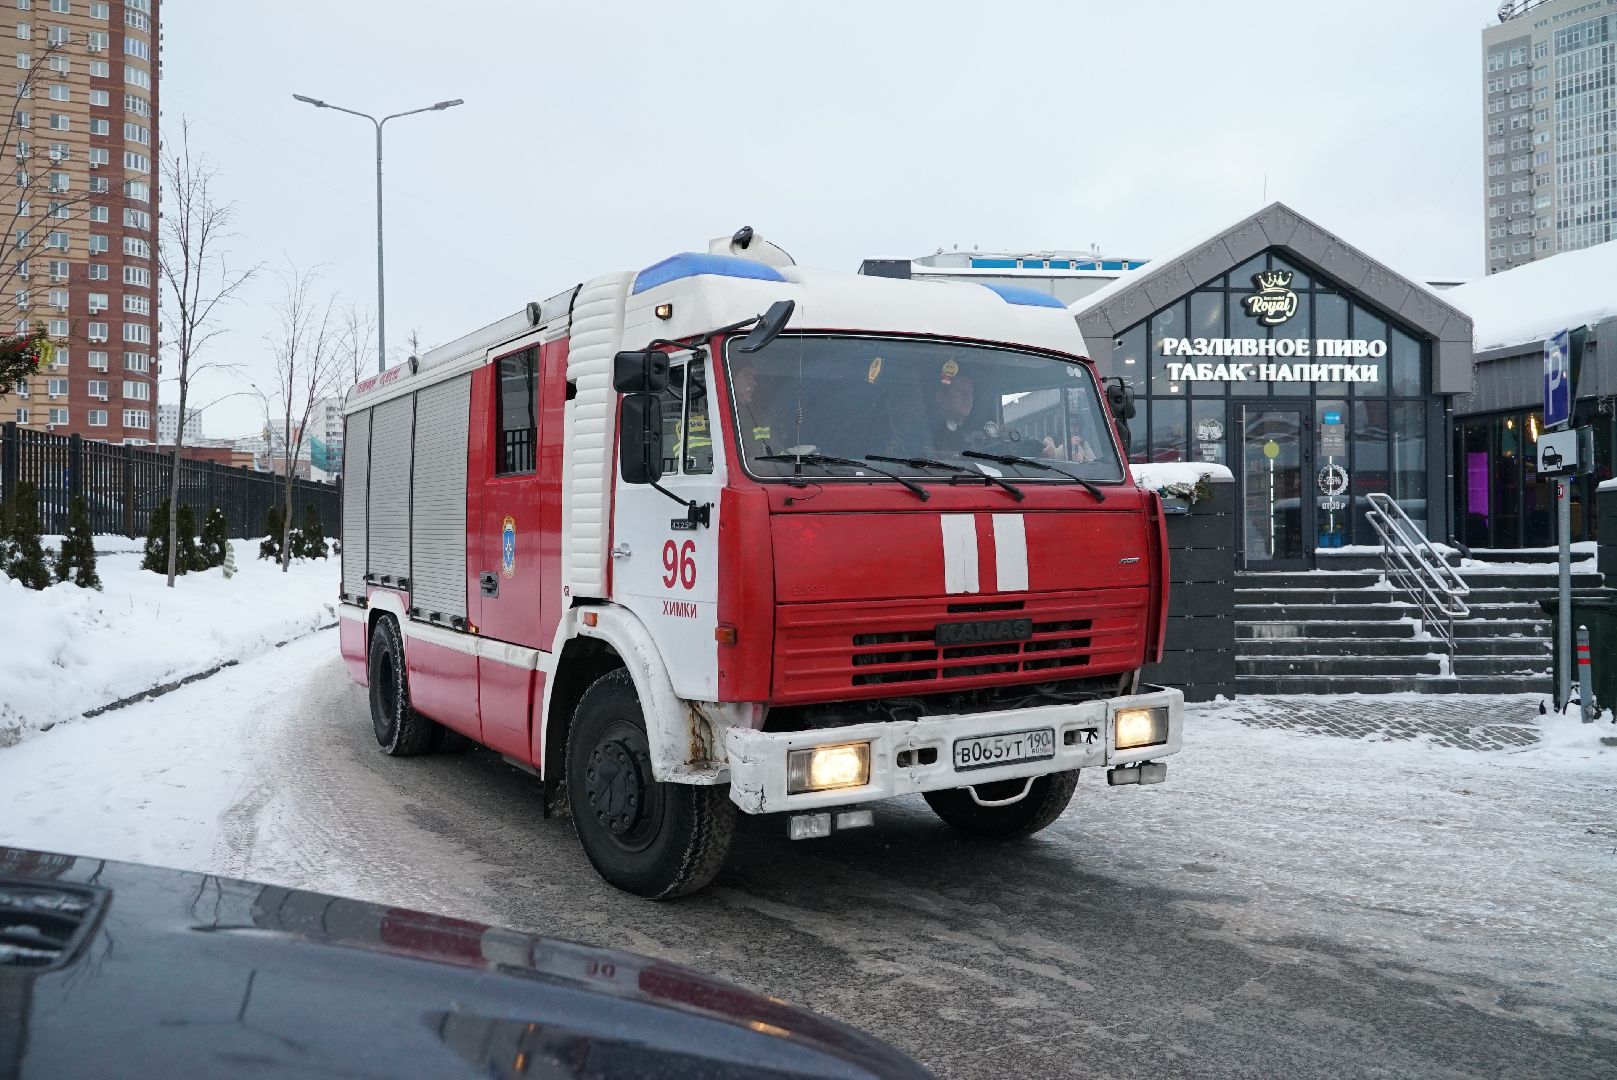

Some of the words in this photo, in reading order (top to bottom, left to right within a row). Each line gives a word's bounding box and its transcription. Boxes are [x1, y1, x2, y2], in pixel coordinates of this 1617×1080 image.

[1248, 296, 1290, 316] Royal
[1162, 337, 1310, 357] РАЗЛИВНОЕ
[1316, 339, 1387, 357] ПИВО
[662, 540, 697, 590] 96
[663, 601, 697, 618] ХИМКИ
